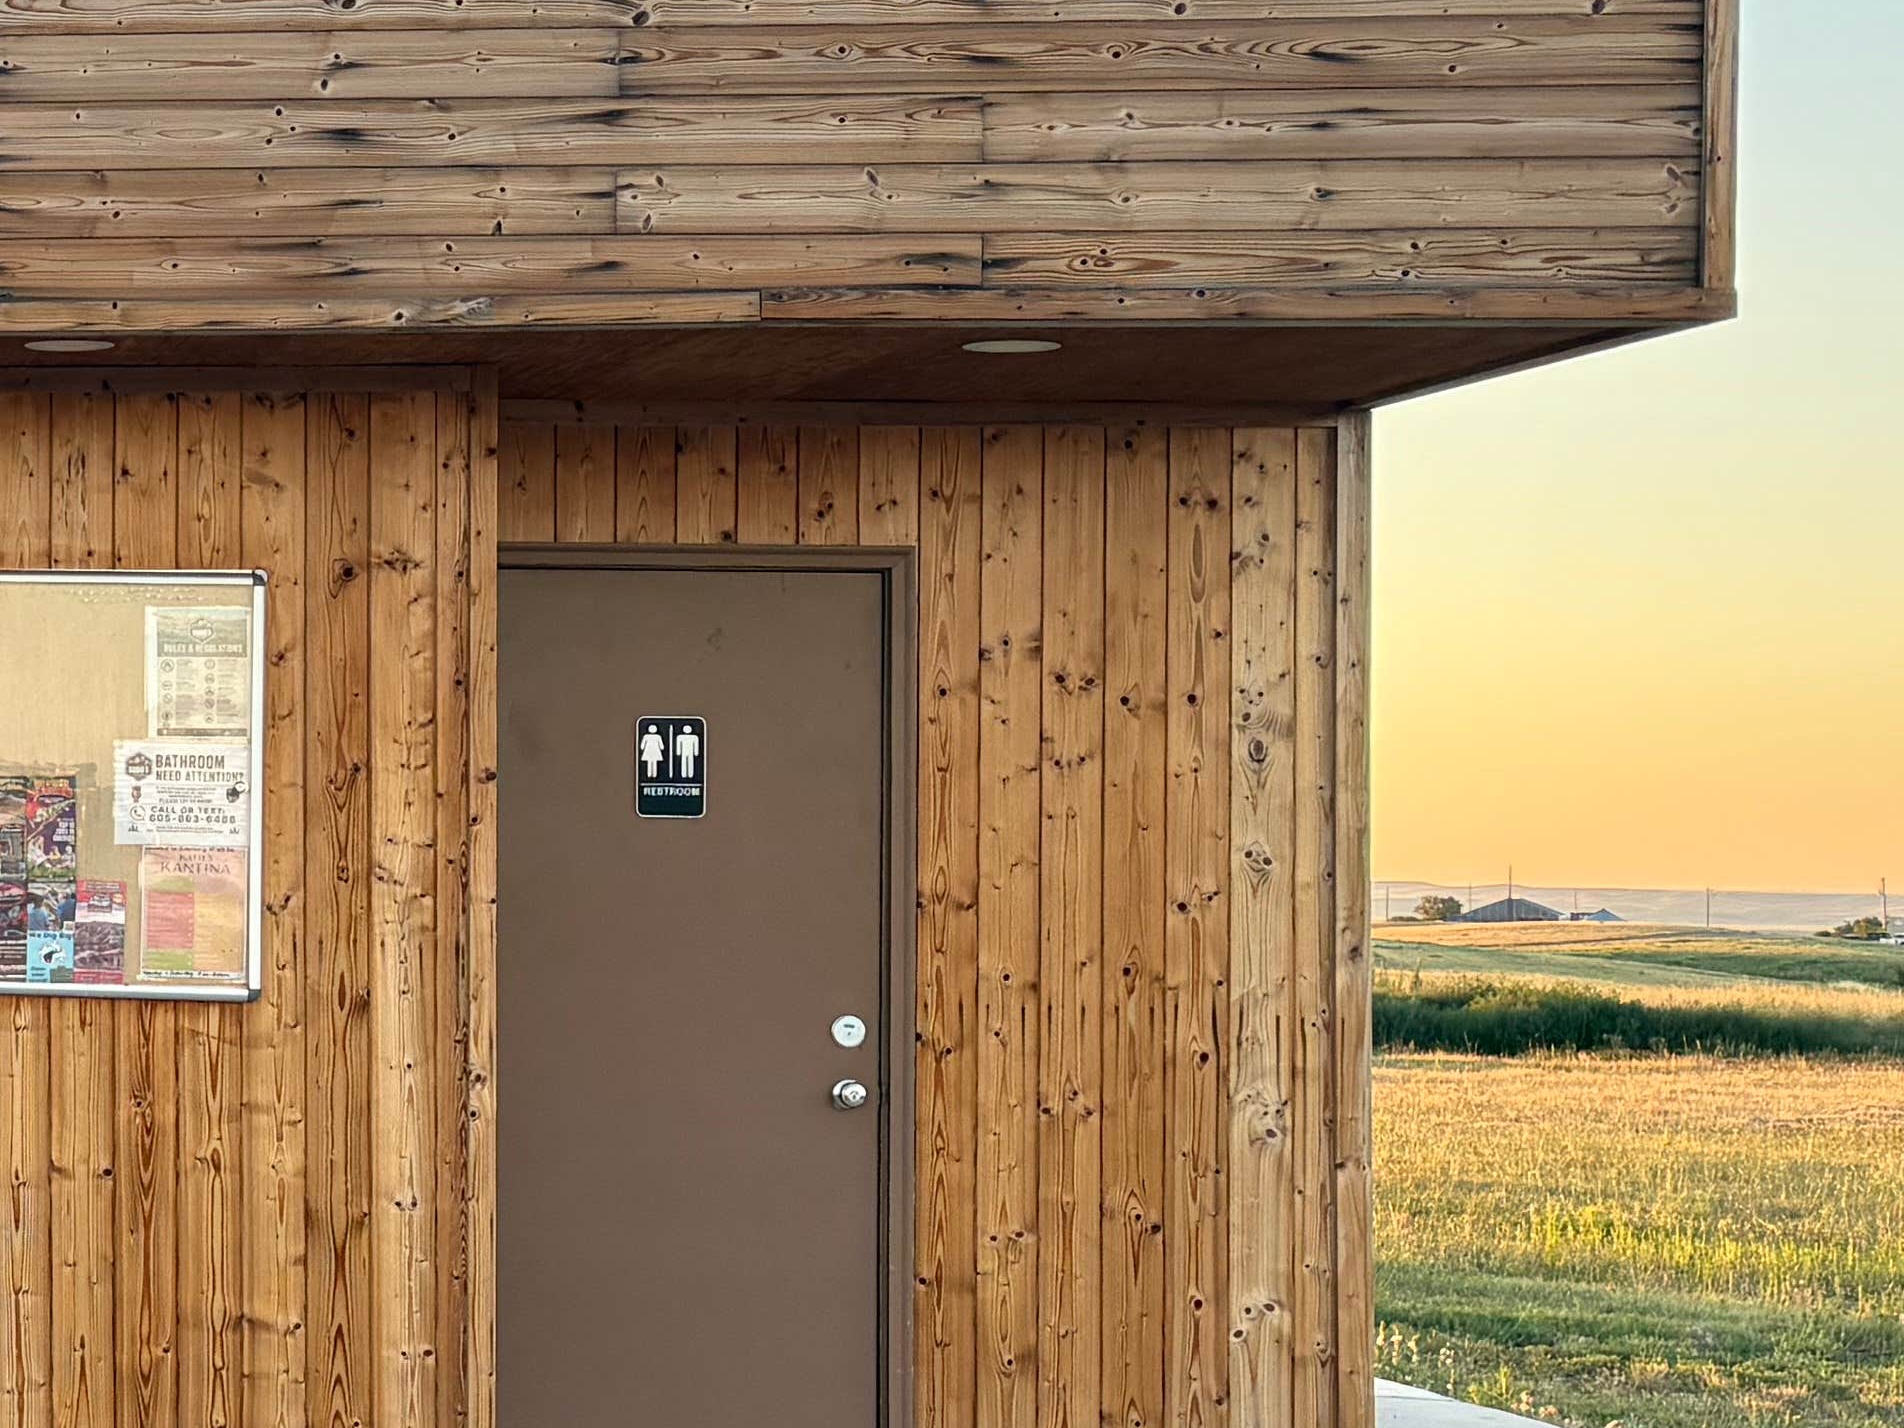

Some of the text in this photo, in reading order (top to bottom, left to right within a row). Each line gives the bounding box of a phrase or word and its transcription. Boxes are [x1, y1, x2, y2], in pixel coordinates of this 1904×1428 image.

[155, 754, 225, 770] BATHROOM
[155, 770, 245, 782] NEED ATTENTION?
[643, 786, 700, 797] RESTROOM
[151, 805, 177, 814] CALL
[180, 806, 194, 814] OR
[160, 861, 231, 875] KANTINA
